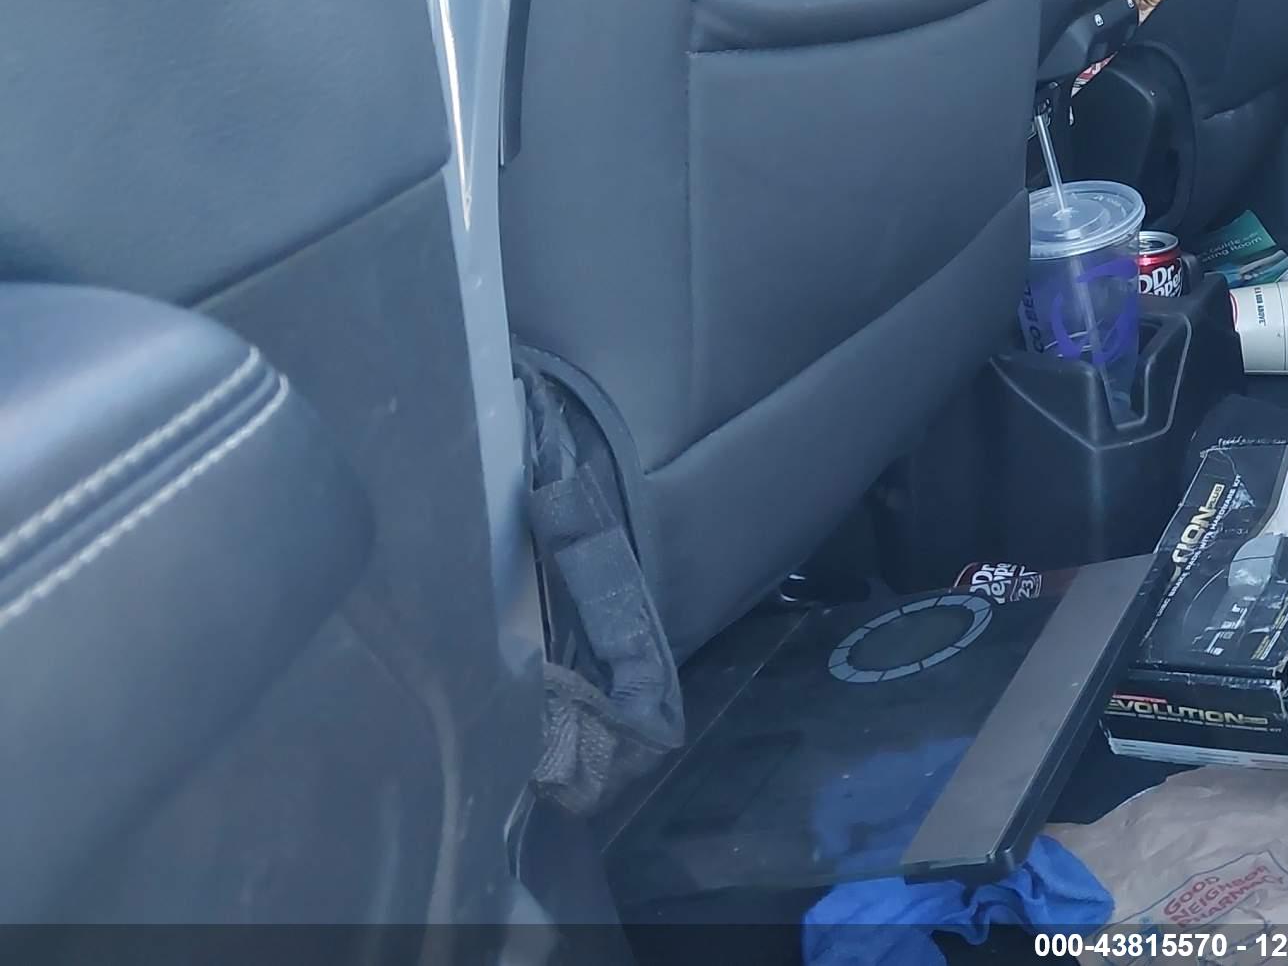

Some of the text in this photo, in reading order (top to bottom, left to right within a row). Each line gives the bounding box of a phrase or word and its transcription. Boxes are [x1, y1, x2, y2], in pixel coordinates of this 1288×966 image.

[1151, 264, 1176, 290] Dr
[1107, 699, 1245, 725] EVOLUTION
[1163, 875, 1220, 916] GOOD
[1170, 865, 1270, 922] NEIGHBOR
